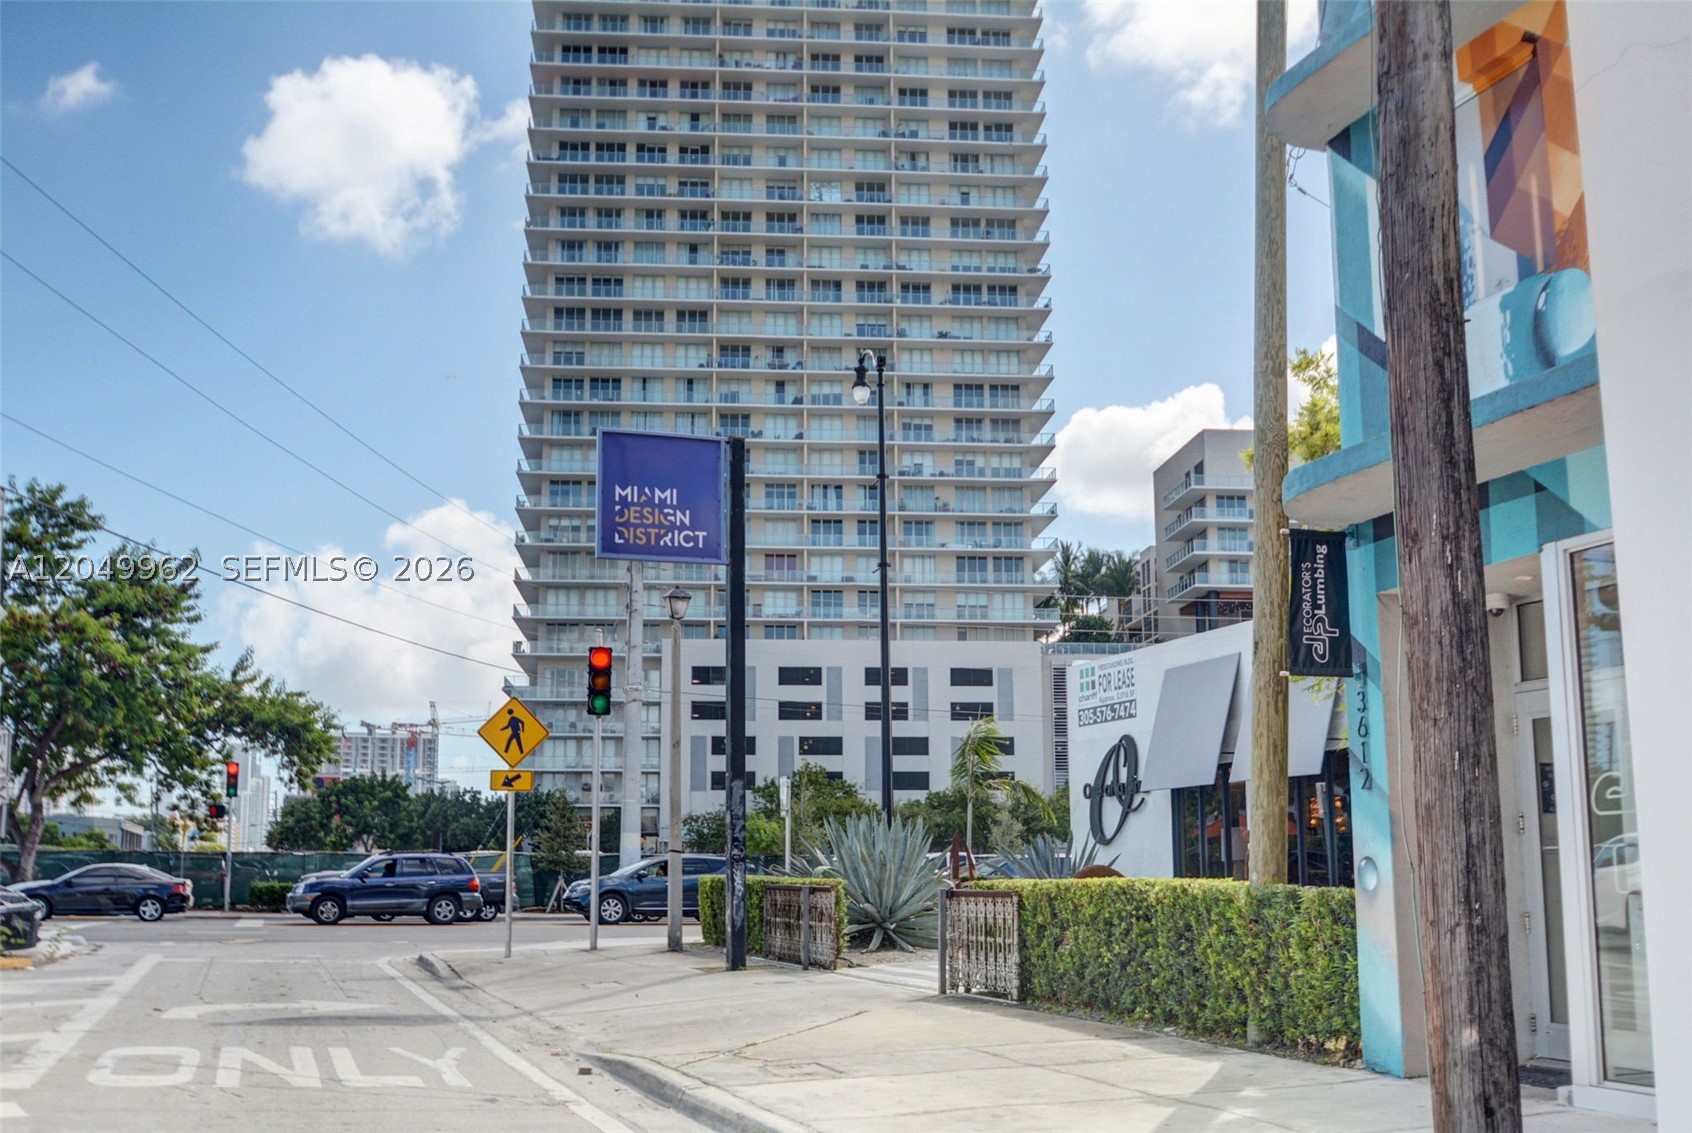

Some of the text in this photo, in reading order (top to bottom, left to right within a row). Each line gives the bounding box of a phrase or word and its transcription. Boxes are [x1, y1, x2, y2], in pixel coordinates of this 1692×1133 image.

[615, 484, 677, 505] MIAMI
[615, 505, 690, 527] DESIGN
[614, 526, 708, 548] DISTRICT
[1098, 667, 1135, 694] FOR LEASE
[1079, 702, 1136, 725] 305-576-7474
[1356, 690, 1372, 791] 3612
[86, 1046, 474, 1088] ONLY
